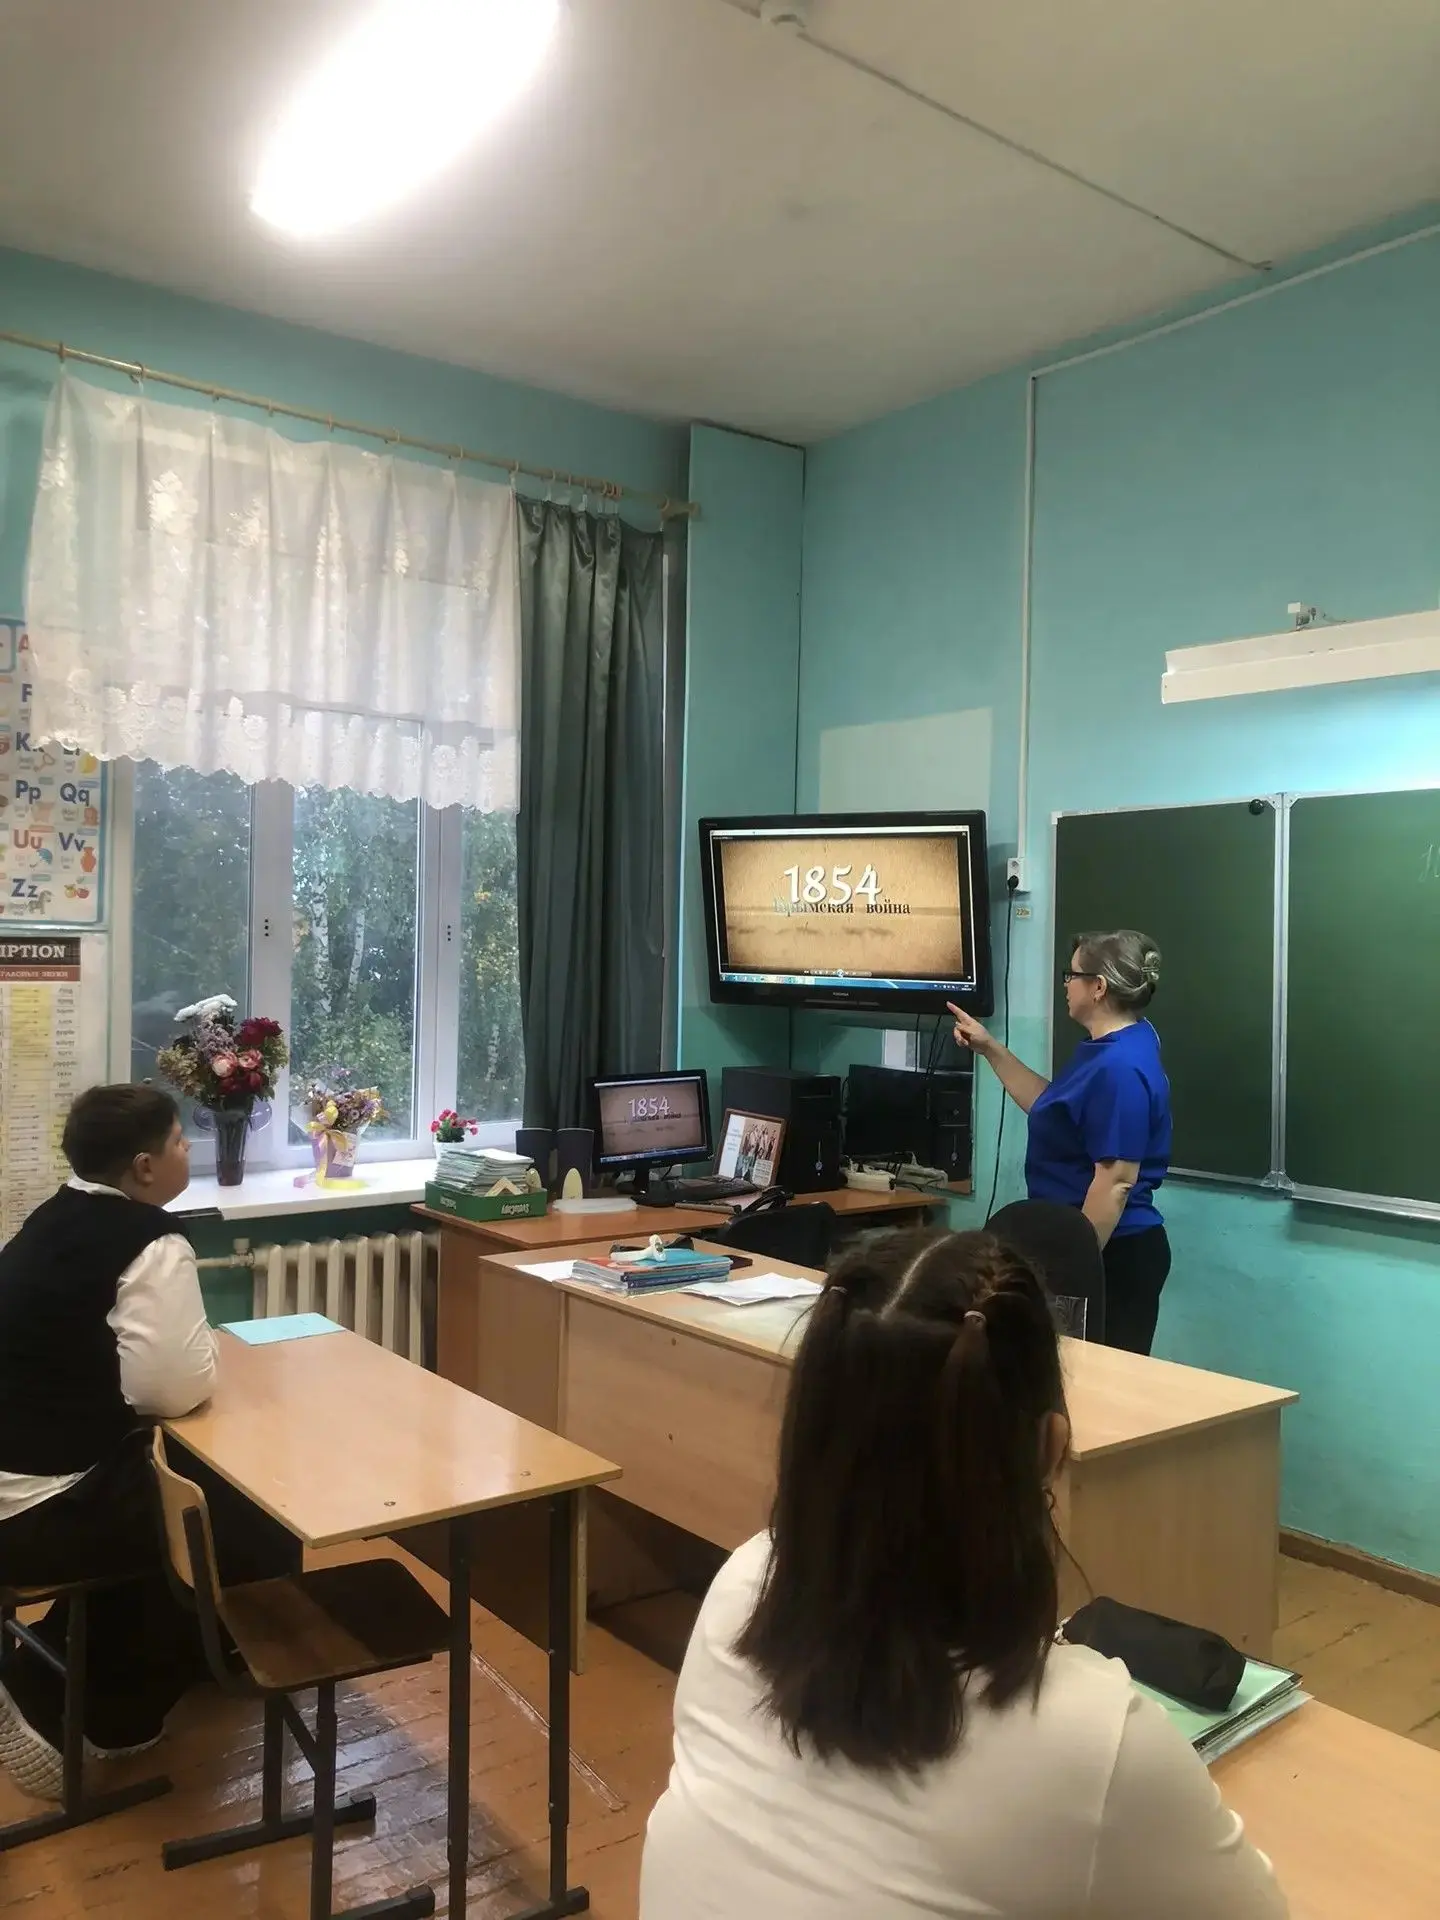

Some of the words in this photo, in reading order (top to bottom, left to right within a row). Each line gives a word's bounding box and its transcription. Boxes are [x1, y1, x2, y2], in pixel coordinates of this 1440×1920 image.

[16, 780, 41, 804] Pp
[60, 783, 90, 806] Qq
[14, 830, 42, 849] Uu
[59, 832, 85, 852] Vv
[12, 879, 37, 898] Zz
[784, 863, 882, 905] 1854
[866, 899, 911, 914] война
[0, 944, 66, 958] IPTION
[628, 1097, 670, 1117] 1854
